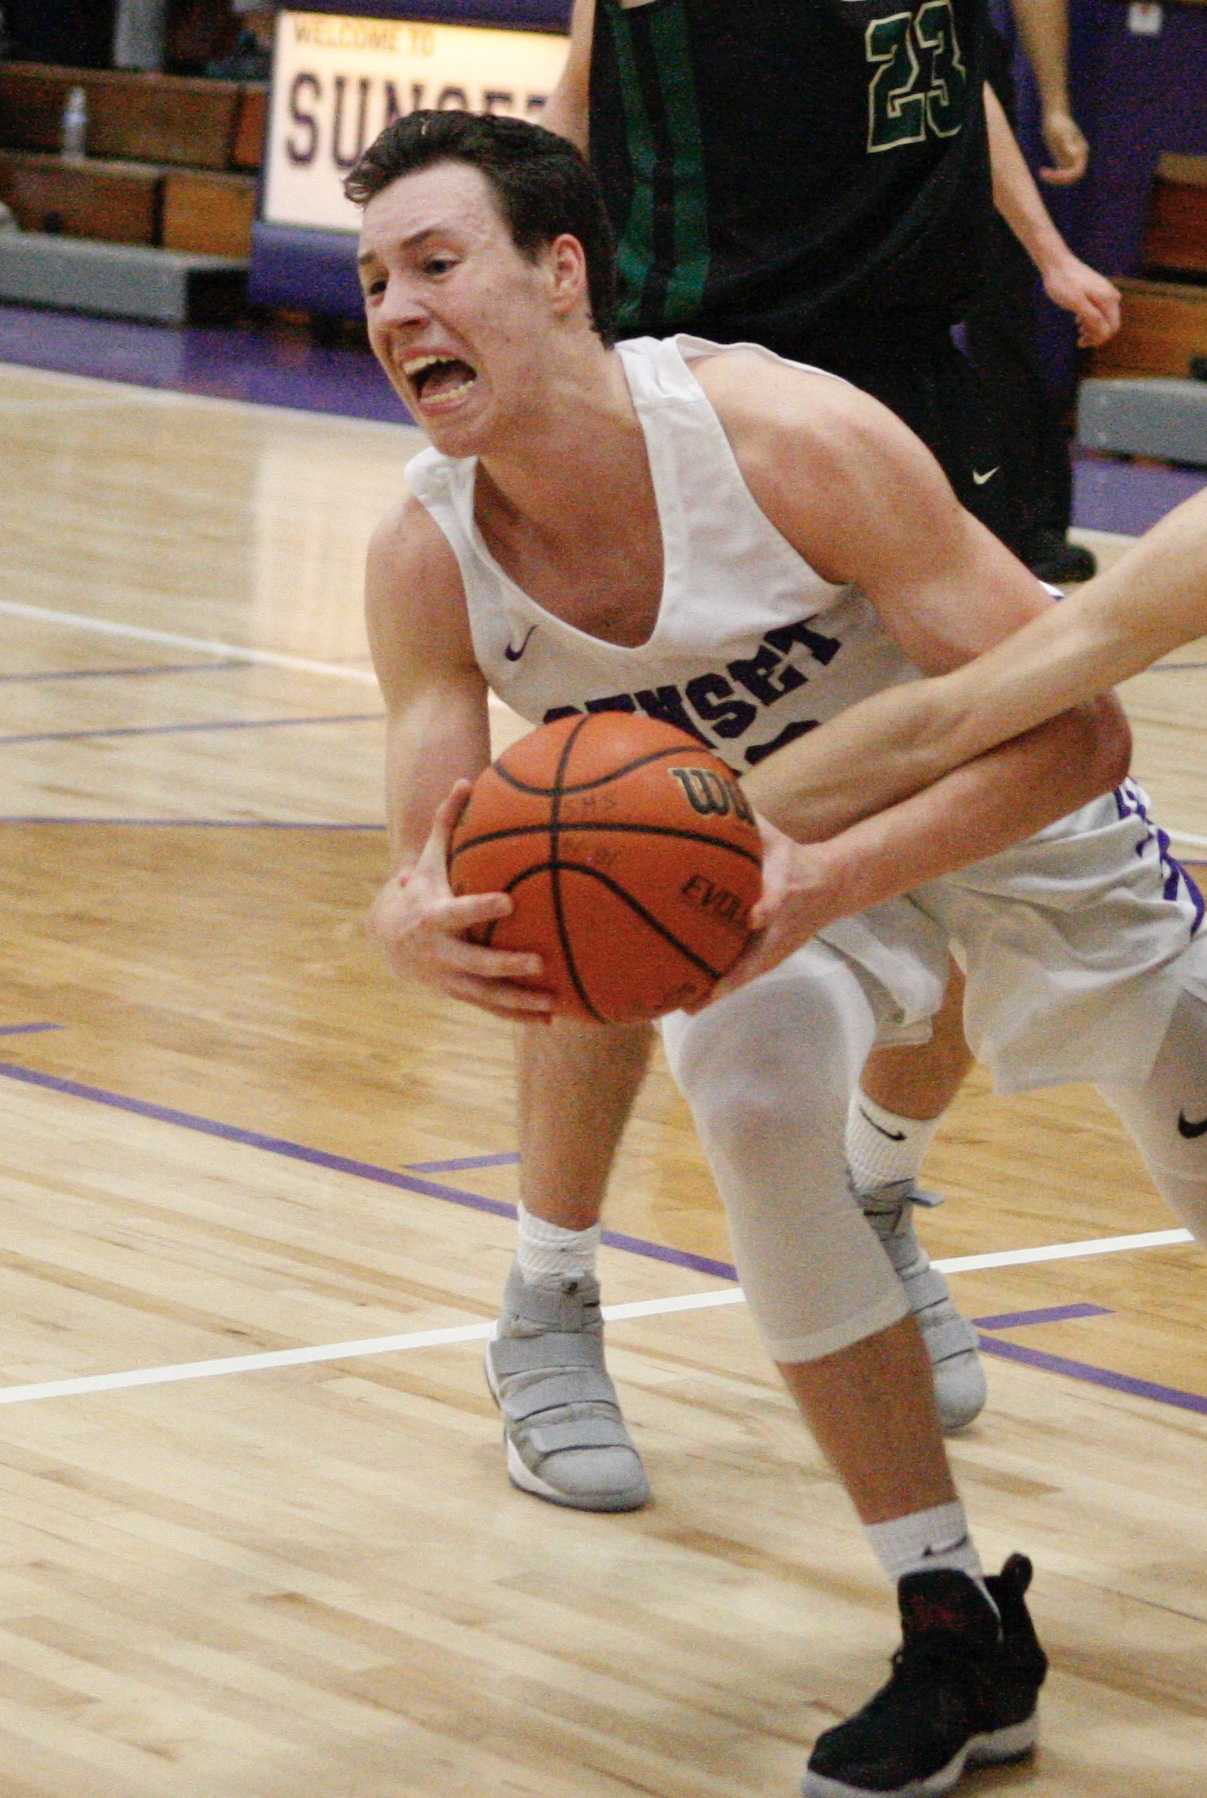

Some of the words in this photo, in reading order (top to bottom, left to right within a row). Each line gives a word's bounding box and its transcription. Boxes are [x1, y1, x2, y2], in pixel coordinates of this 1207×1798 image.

[407, 28, 434, 56] TO
[865, 0, 968, 153] 23
[543, 614, 842, 750] NSET
